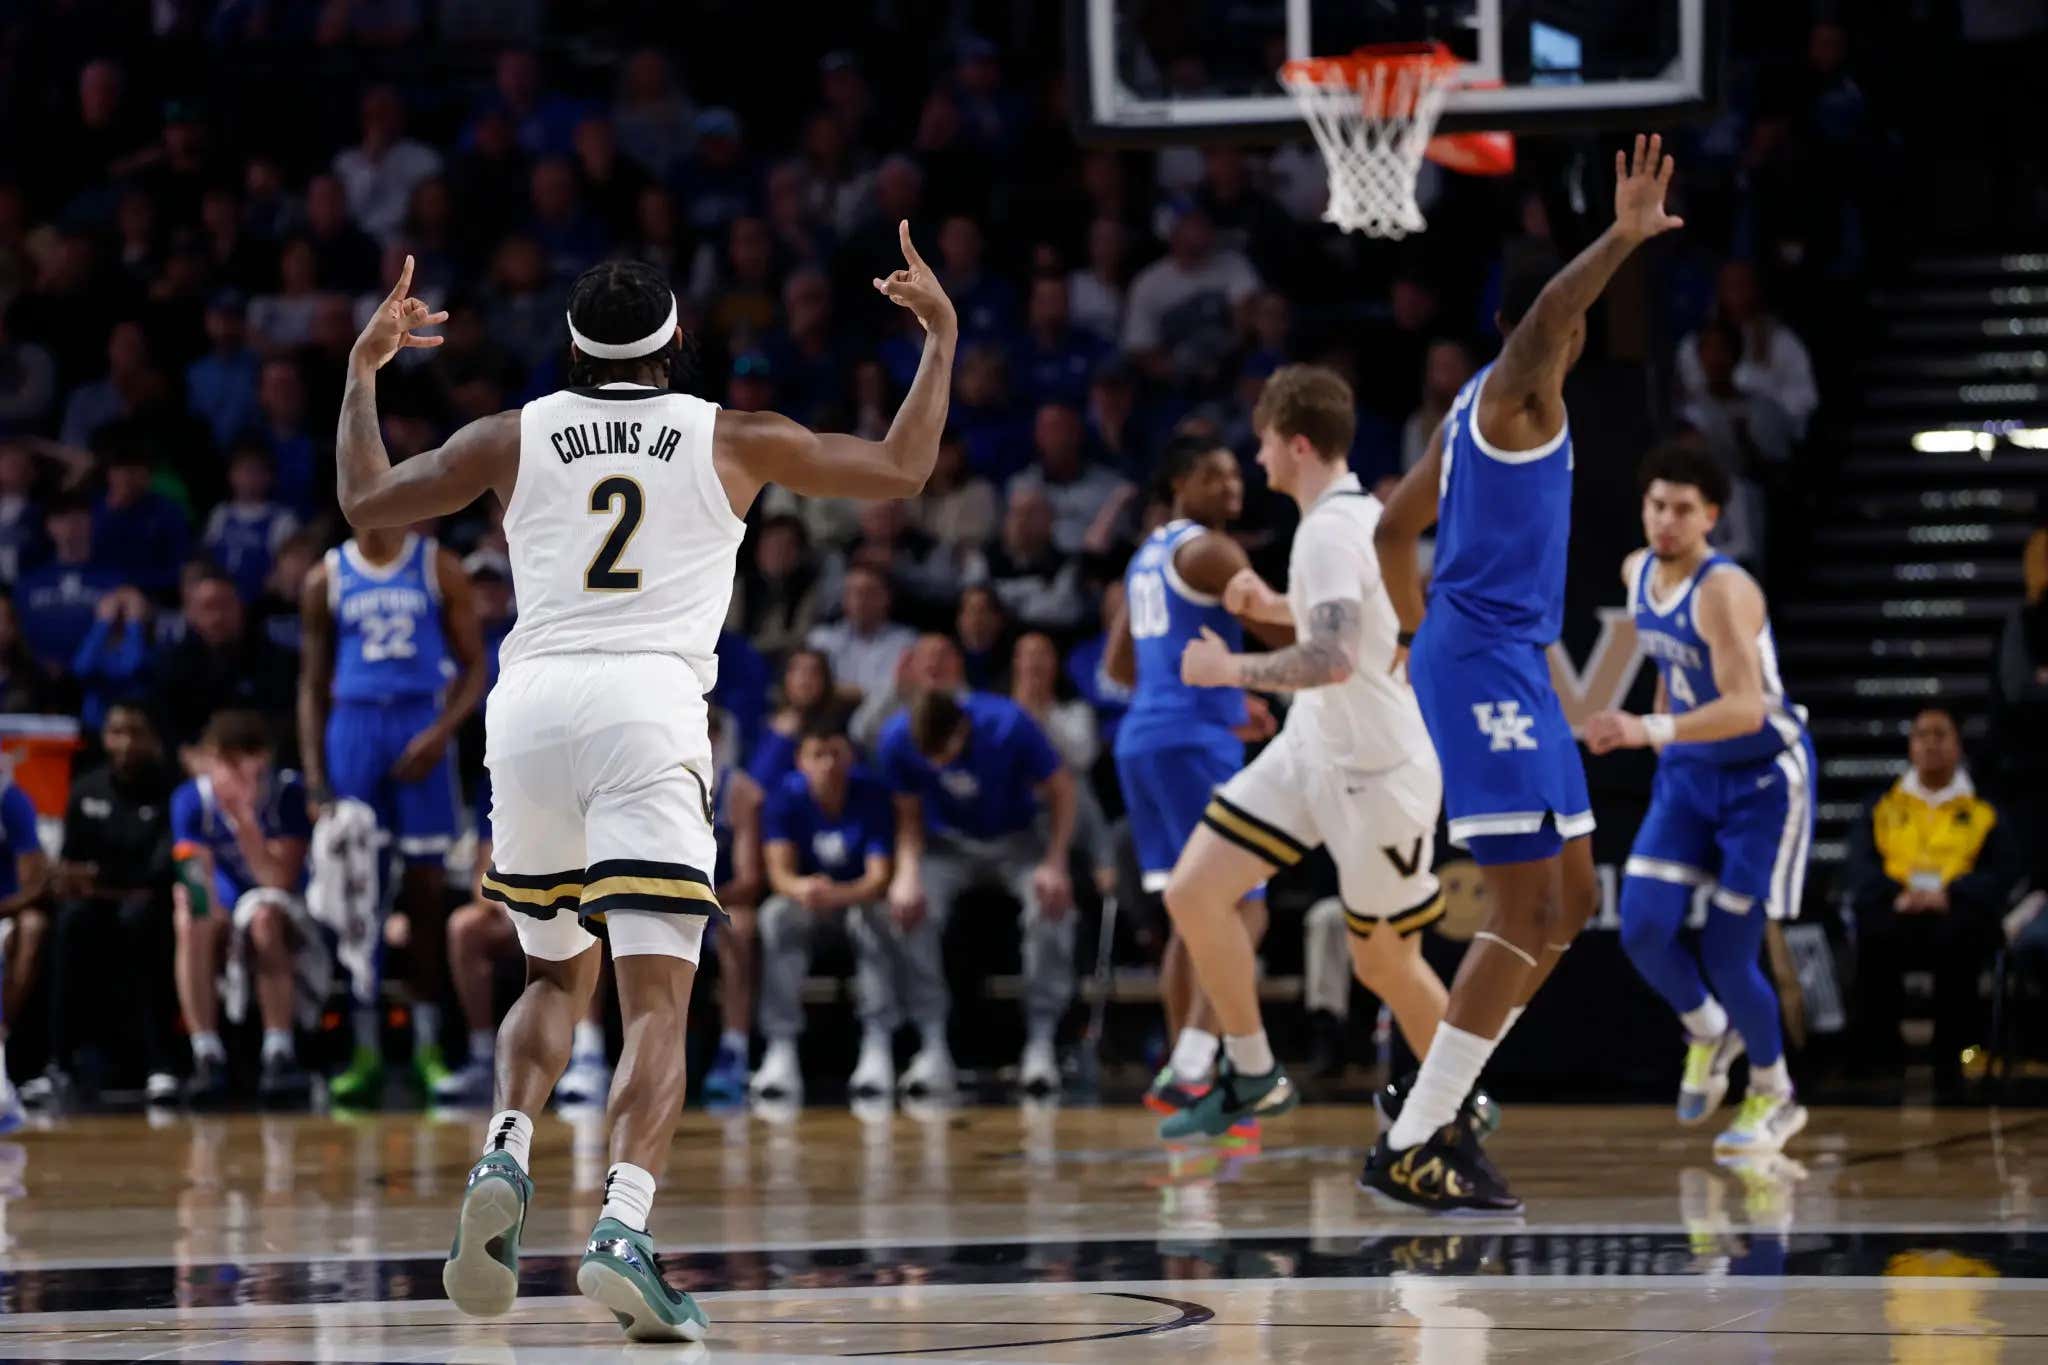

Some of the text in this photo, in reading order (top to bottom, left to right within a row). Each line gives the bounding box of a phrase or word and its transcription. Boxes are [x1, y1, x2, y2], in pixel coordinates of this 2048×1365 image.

[550, 421, 683, 464] COLLINS JR
[583, 474, 646, 592] 2
[360, 612, 417, 661] 22
[1670, 660, 1698, 708] 4
[1471, 699, 1538, 752] UK
[1379, 834, 1425, 880] V
